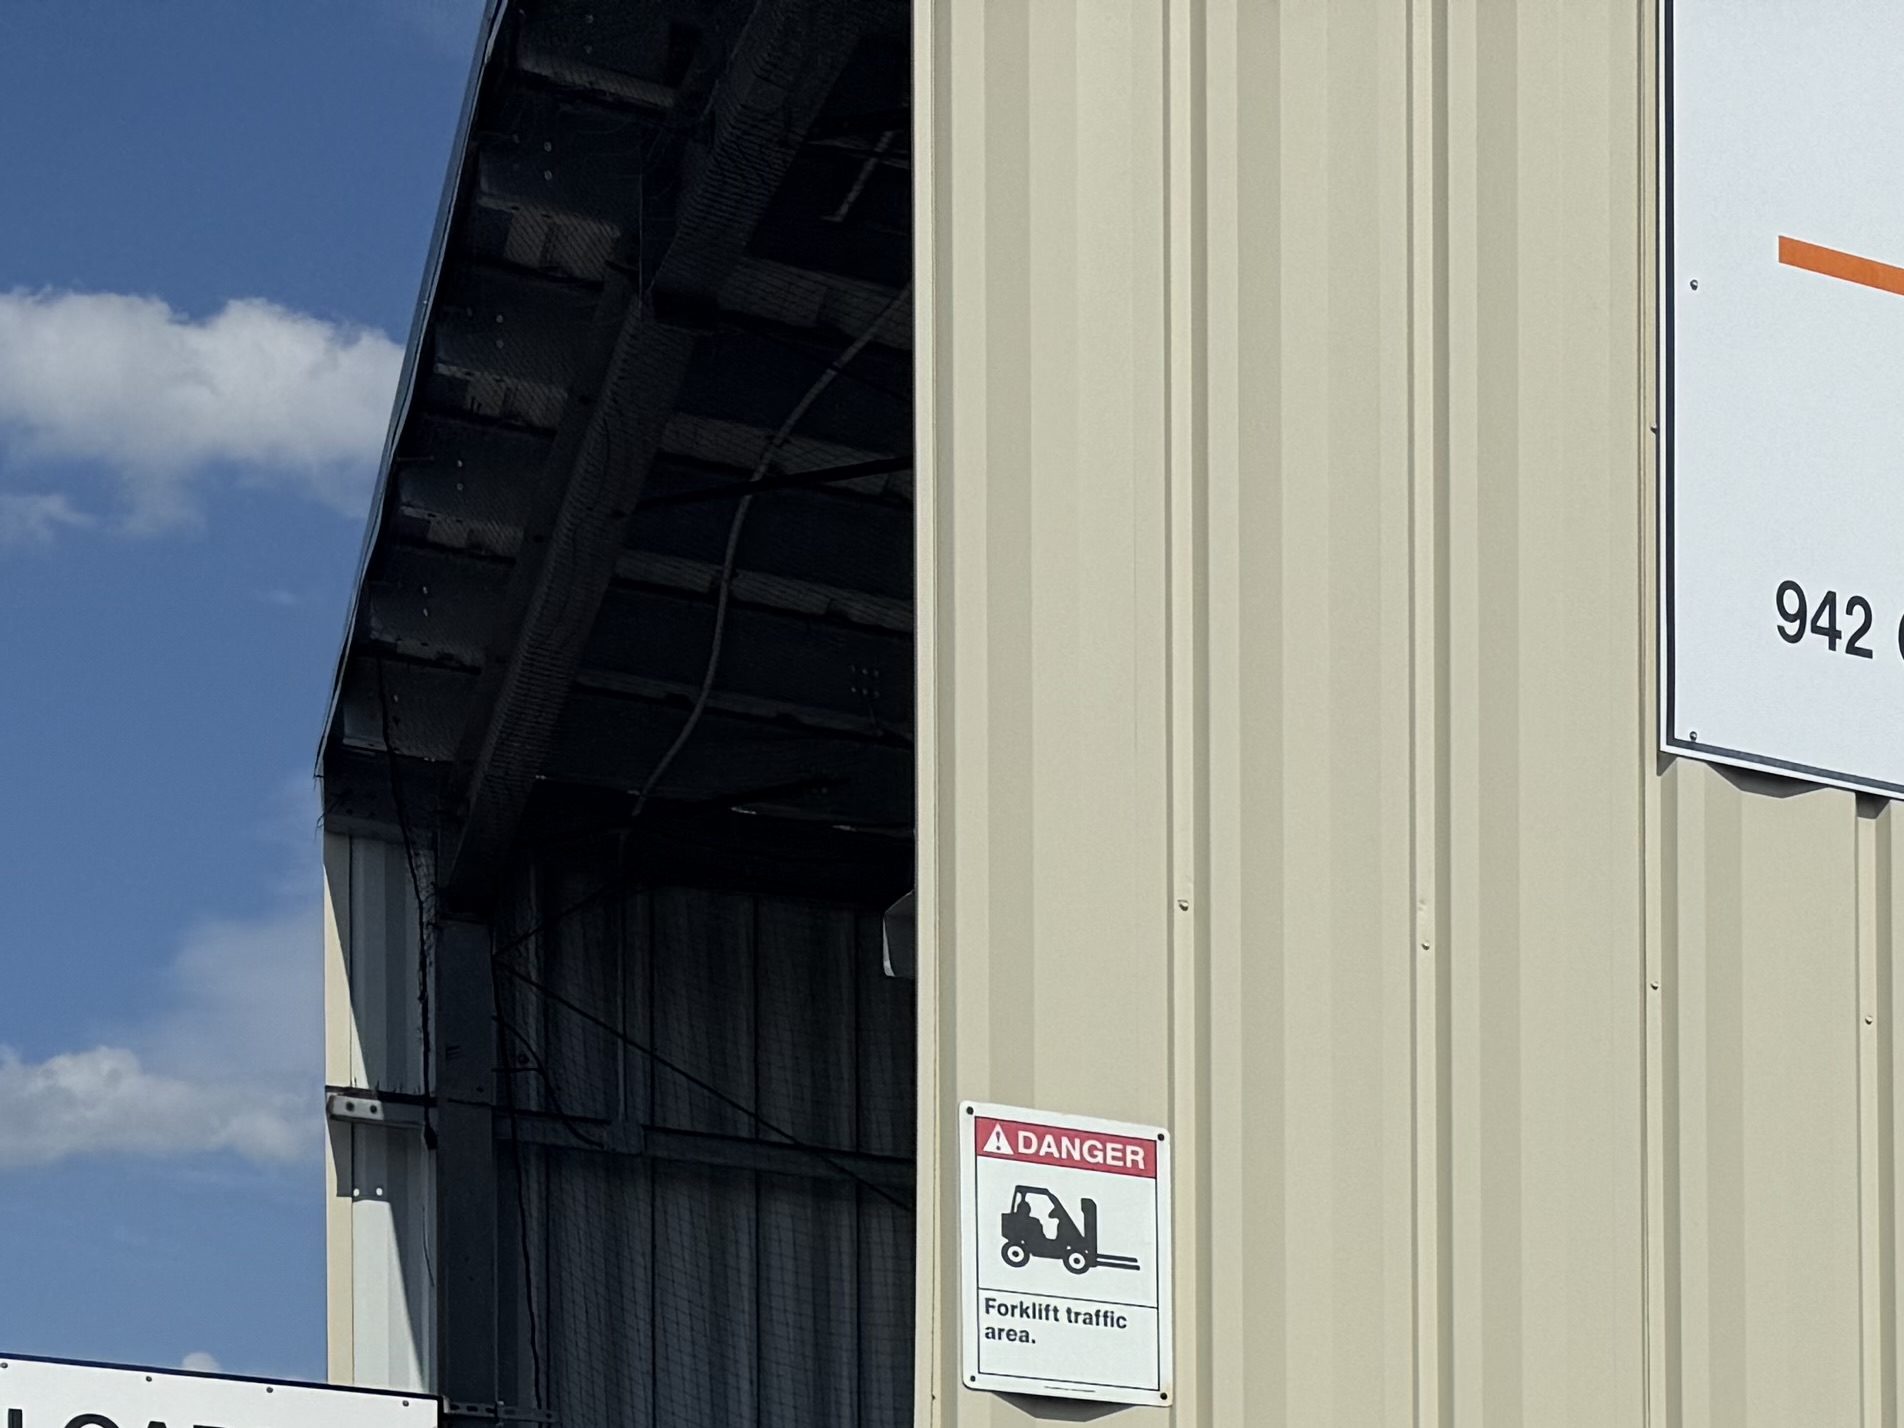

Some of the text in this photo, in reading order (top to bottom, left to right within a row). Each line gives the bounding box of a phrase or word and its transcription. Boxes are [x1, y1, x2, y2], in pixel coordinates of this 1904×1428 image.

[1775, 580, 1873, 660] 942
[1018, 1130, 1145, 1170] DANGER
[984, 1297, 1127, 1329] Forklift traffic
[984, 1326, 1036, 1344] area.
